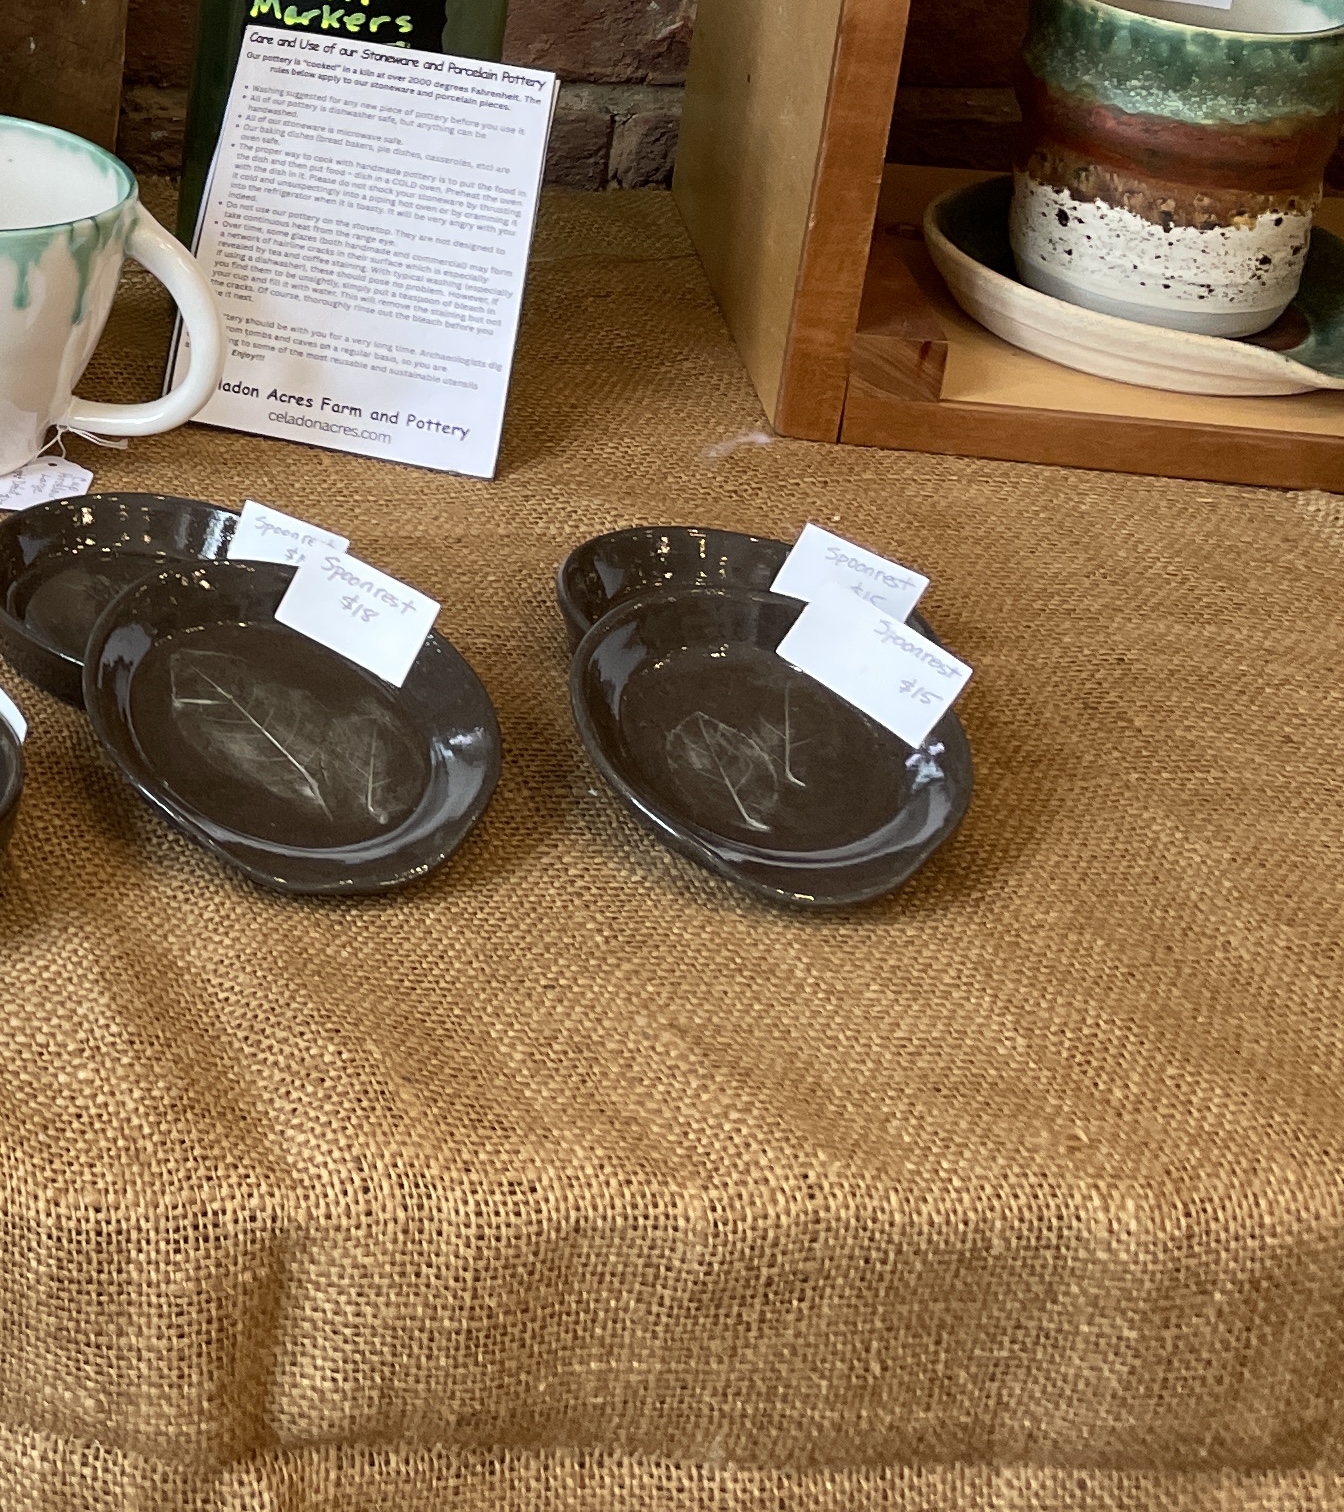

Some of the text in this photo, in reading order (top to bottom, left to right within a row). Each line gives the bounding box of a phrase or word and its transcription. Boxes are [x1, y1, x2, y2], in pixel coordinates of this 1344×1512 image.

[248, 30, 546, 91] Care and Use of our Stoneware and Porcelain Pottery
[265, 387, 314, 408] Acres
[319, 396, 362, 418] Farm
[369, 410, 399, 425] and
[405, 413, 469, 441] Pottery
[268, 410, 392, 445] celadonacres.com
[340, 594, 380, 622] $18
[899, 678, 944, 705] $15
